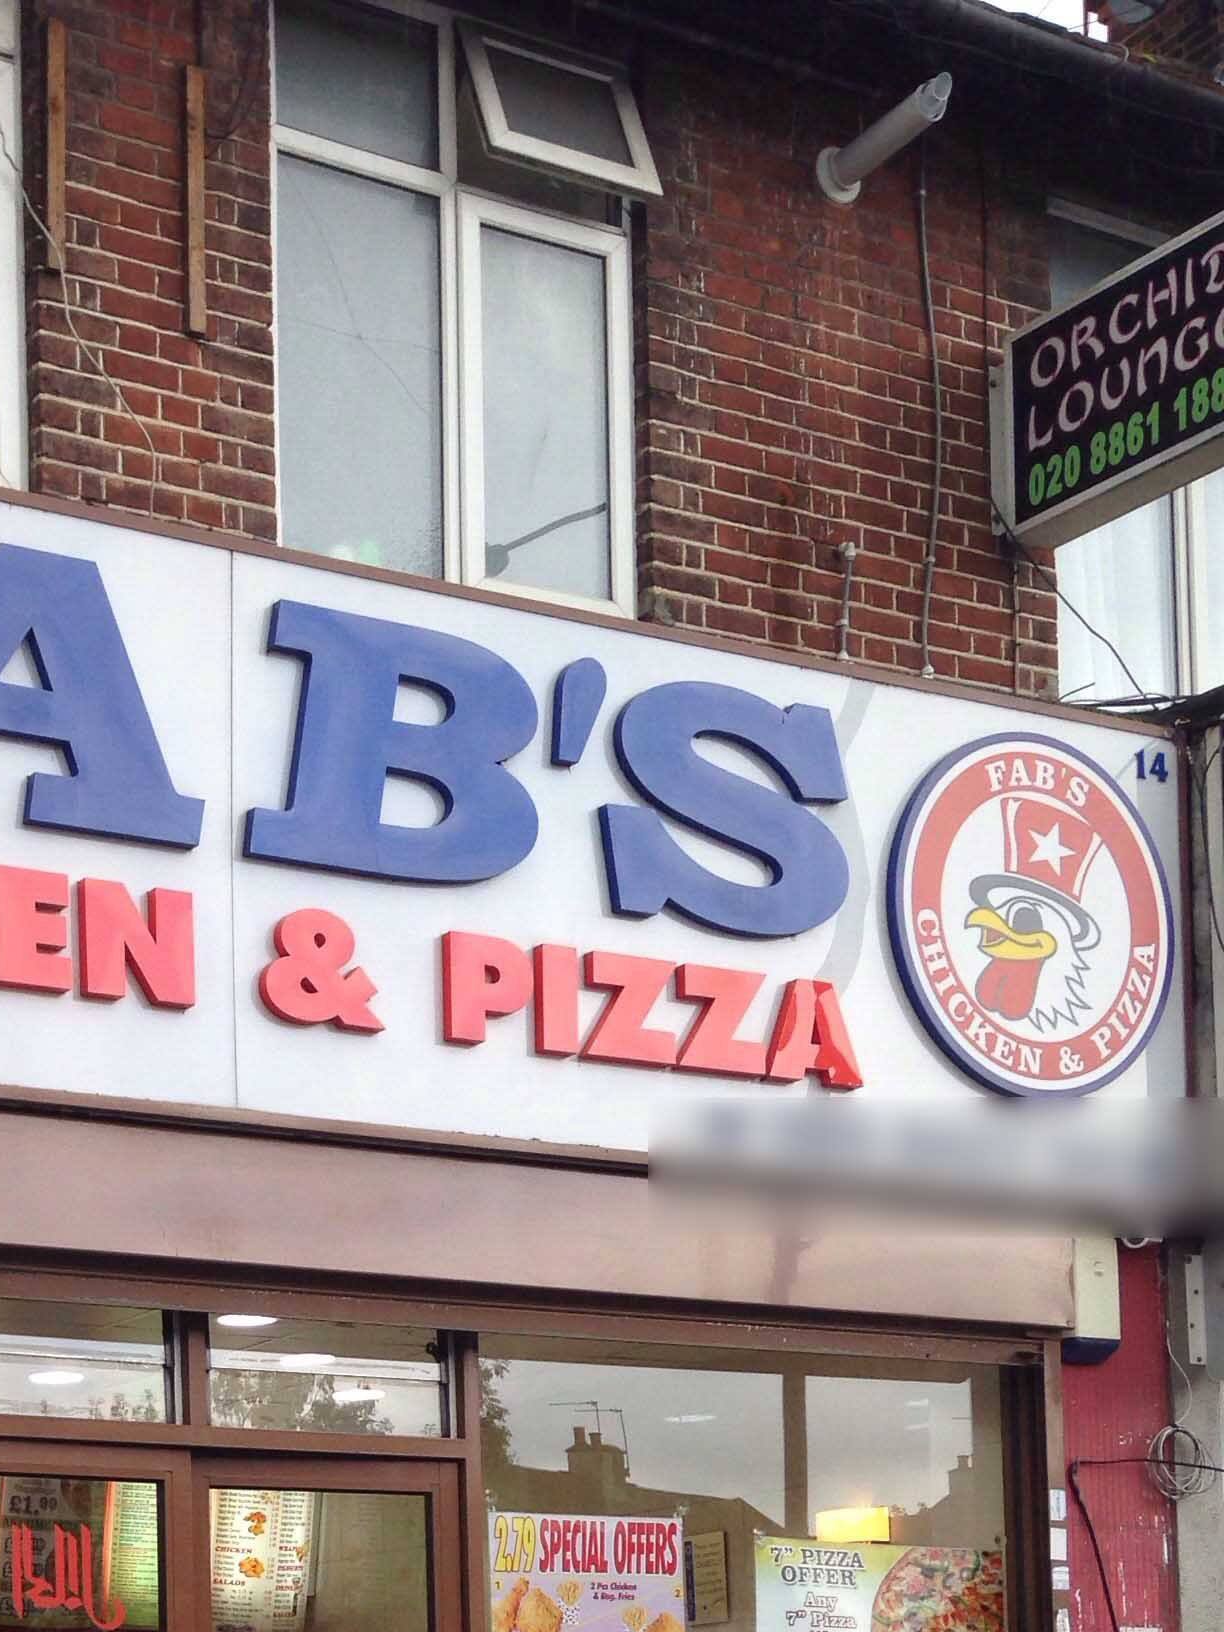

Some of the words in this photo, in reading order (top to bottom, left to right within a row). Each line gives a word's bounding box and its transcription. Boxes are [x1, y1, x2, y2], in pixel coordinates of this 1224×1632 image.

[1029, 445, 1080, 505] 020
[1090, 401, 1160, 475] 8861
[984, 758, 1091, 808] FAB'S
[1134, 748, 1169, 783] 14
[259, 908, 386, 1035] &
[441, 929, 864, 1090] PIZZA
[916, 908, 1042, 1075] CHICKEN
[1059, 1047, 1084, 1075] &
[1090, 944, 1156, 1060] PIZZA
[494, 1515, 536, 1573] 2.79
[539, 1518, 608, 1573] SPECIAL
[614, 1520, 677, 1576] OFFERS
[801, 1547, 864, 1569] PIZZA
[781, 1565, 857, 1588] OFFER
[804, 1592, 838, 1612] Any
[811, 1611, 856, 1629] Pizza
